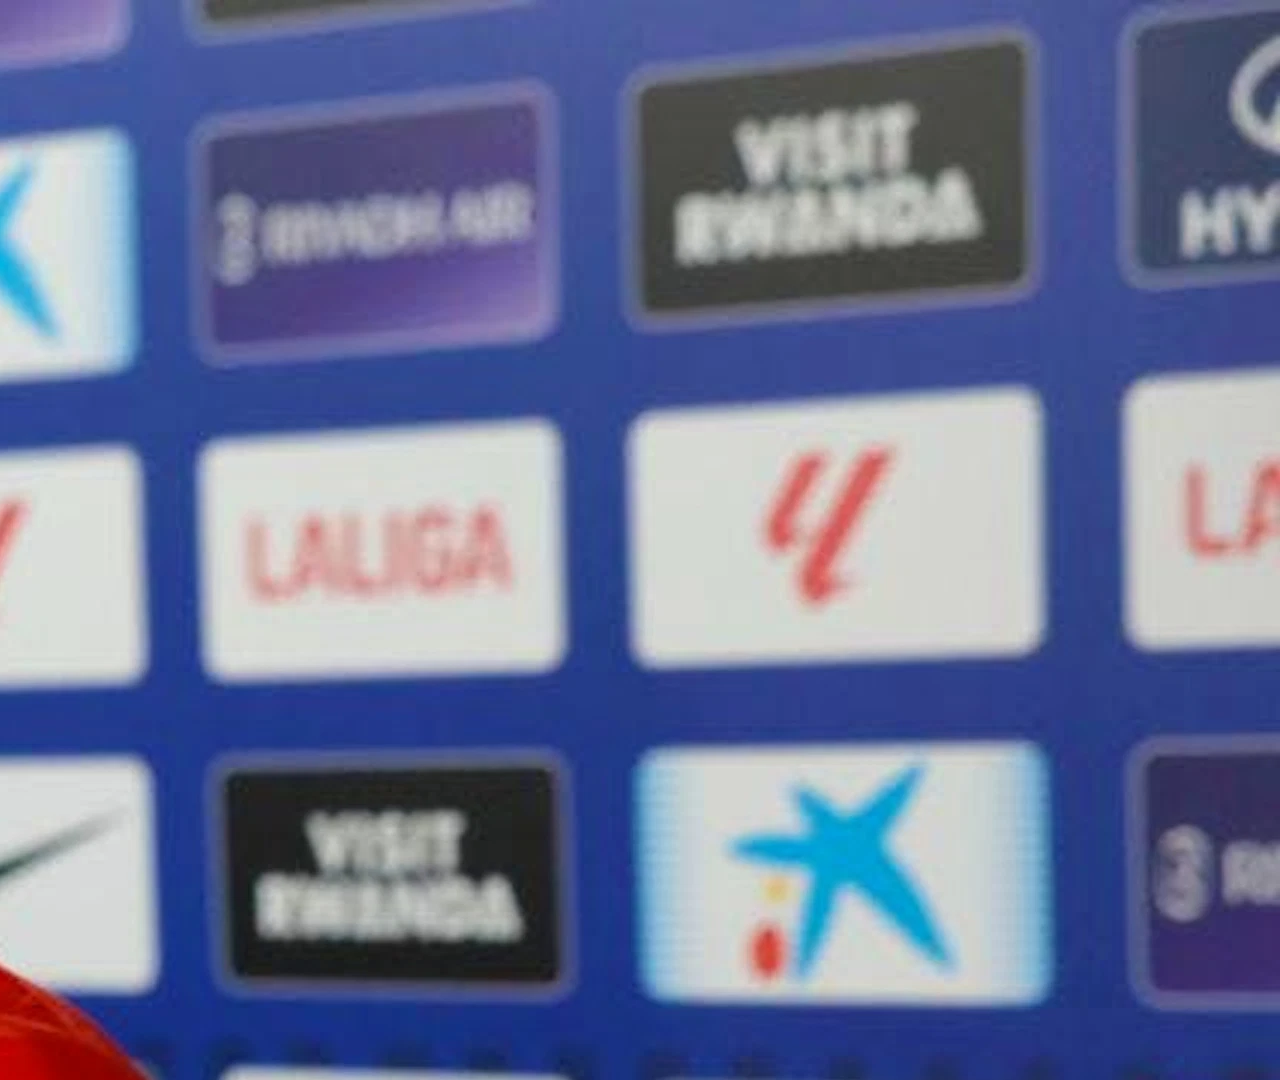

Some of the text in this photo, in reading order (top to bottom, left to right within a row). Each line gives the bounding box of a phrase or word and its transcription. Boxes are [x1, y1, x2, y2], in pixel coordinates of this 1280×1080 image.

[736, 103, 923, 186] VISIT
[245, 502, 516, 605] LALIGA
[306, 810, 466, 872] VISIT
